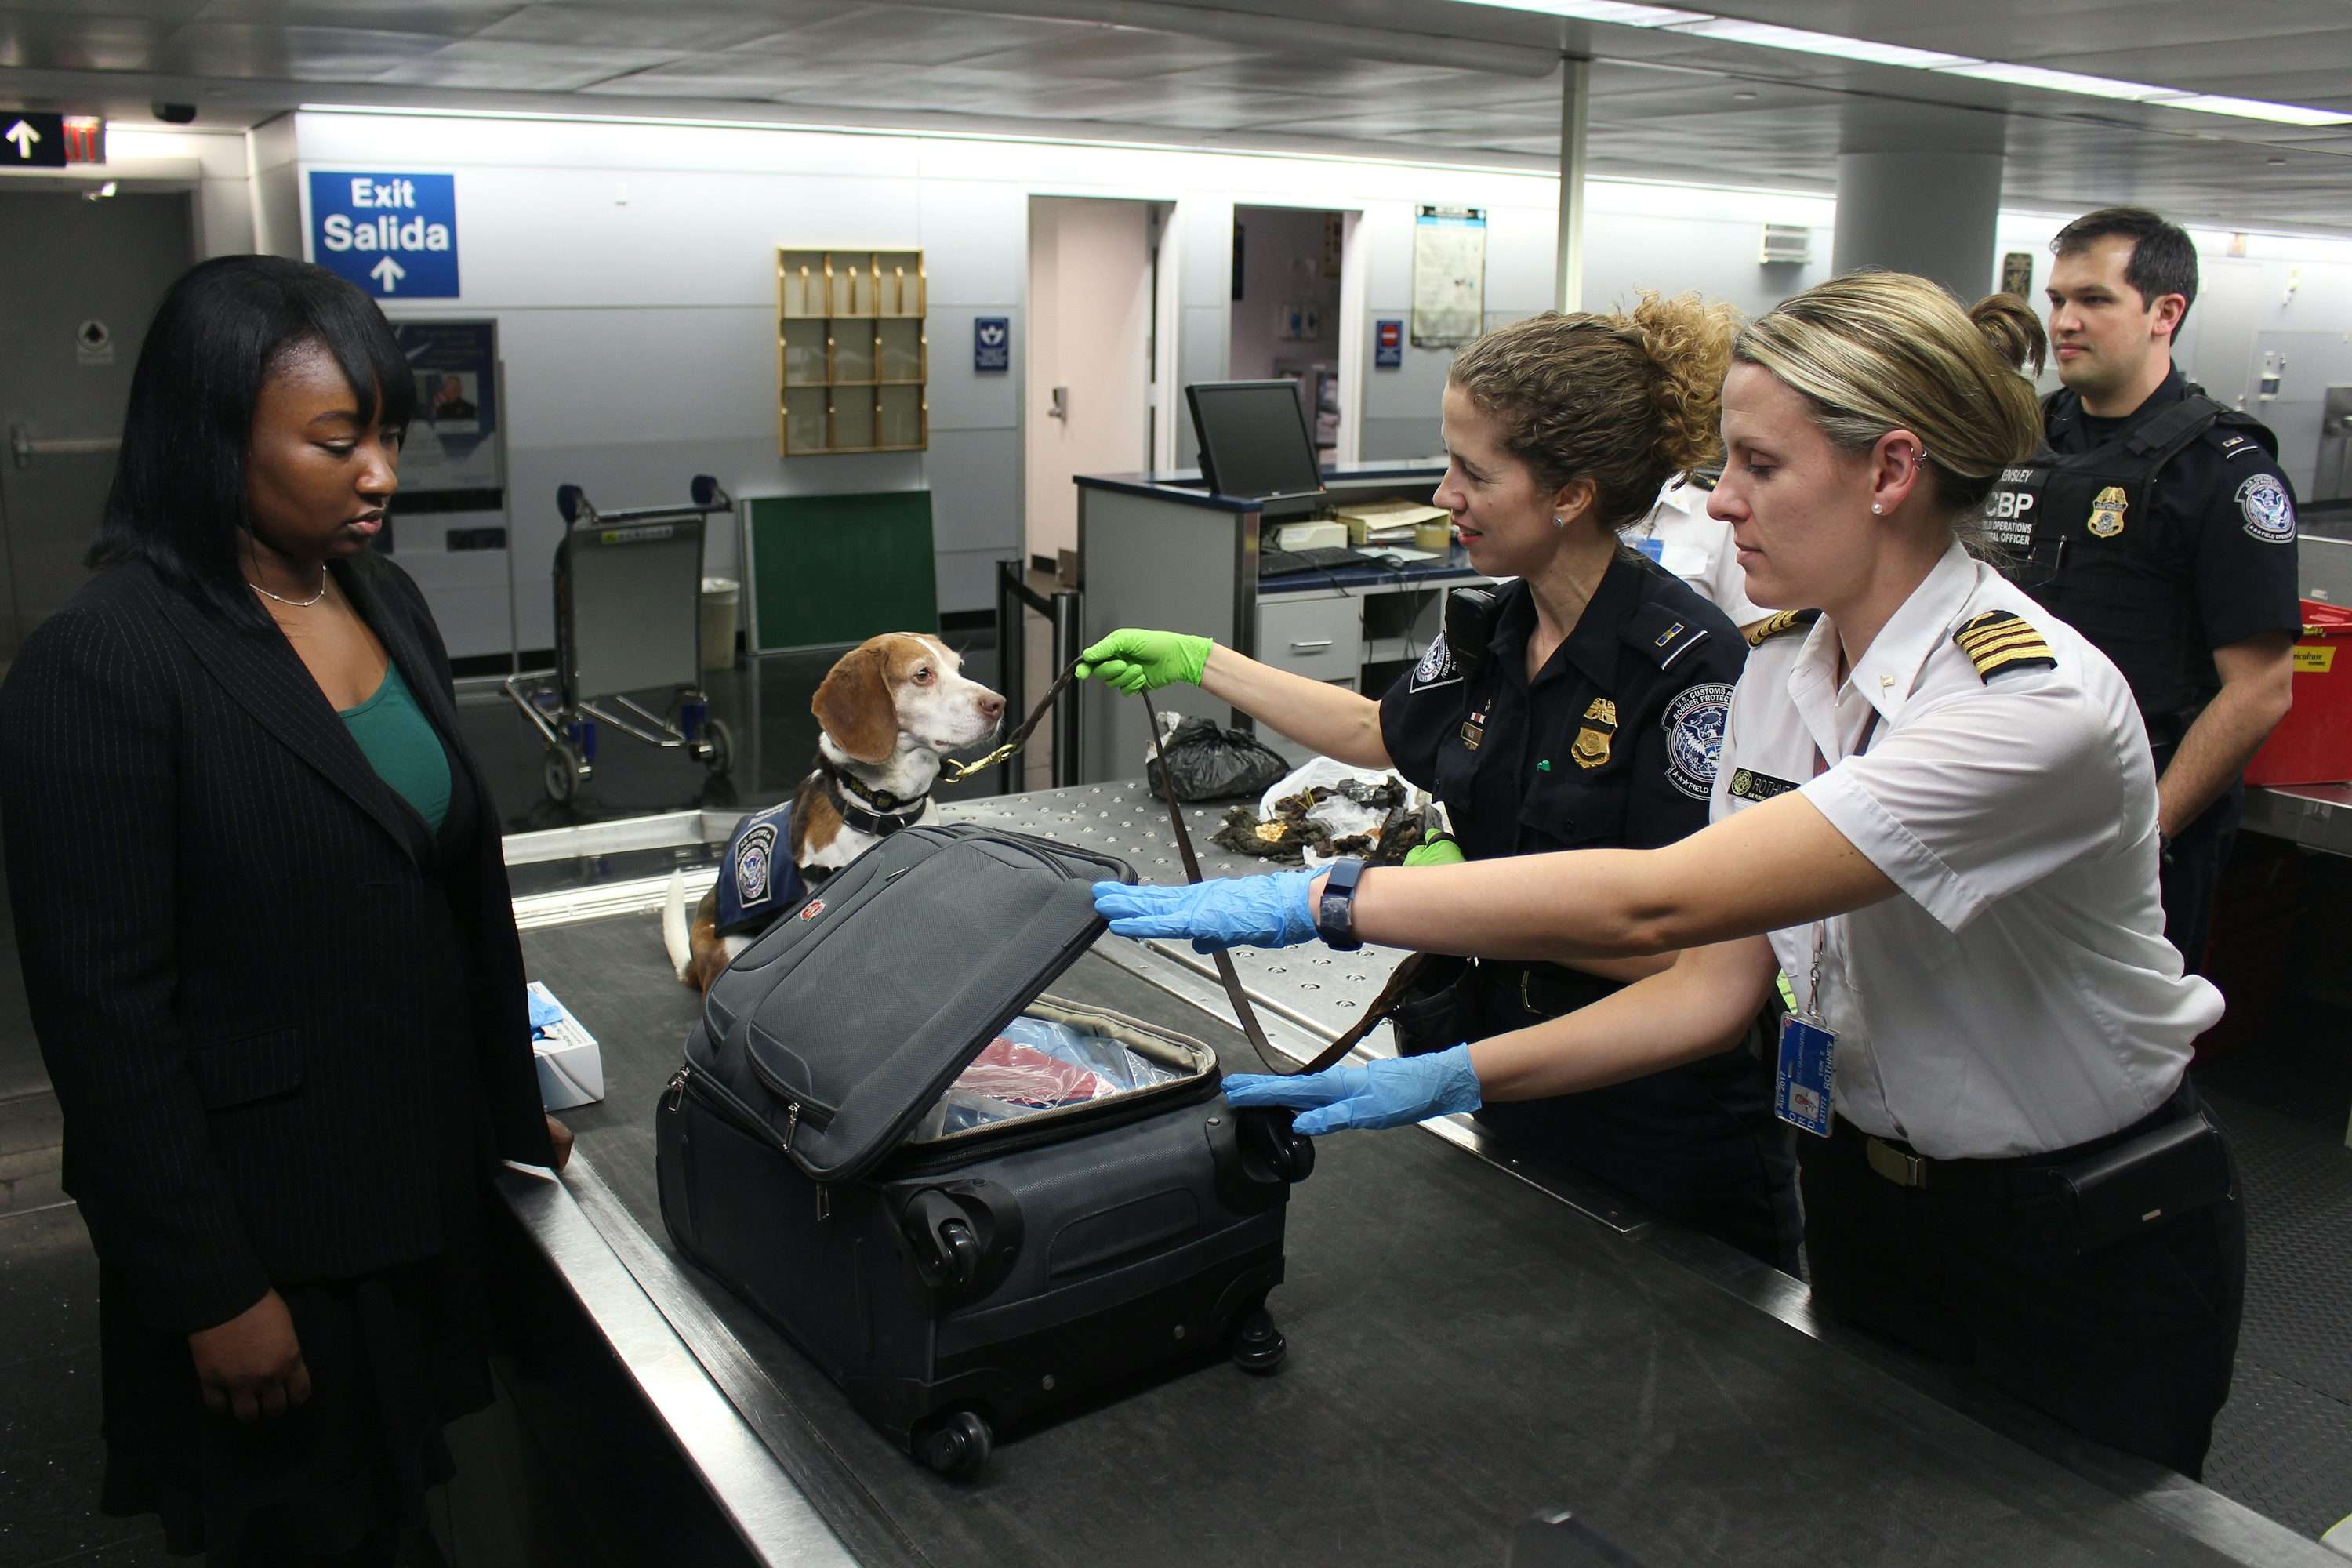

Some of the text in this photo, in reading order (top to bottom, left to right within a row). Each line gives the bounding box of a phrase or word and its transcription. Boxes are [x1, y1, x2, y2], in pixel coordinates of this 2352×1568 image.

[351, 178, 416, 209] Exit
[323, 213, 450, 252] Salida
[1985, 492, 2034, 519] CBP
[1992, 521, 2032, 534] OPERATIONS
[2001, 533, 2030, 546] OFFICER
[1673, 694, 1730, 720] BORDER PROTEC
[1675, 695, 1690, 708] U.S.
[1690, 687, 1726, 699] CUSTOMS
[1688, 782, 1709, 794] FIELD
[1823, 1040, 1834, 1091] ROTHNEY
[1778, 1070, 1788, 1092] 2017
